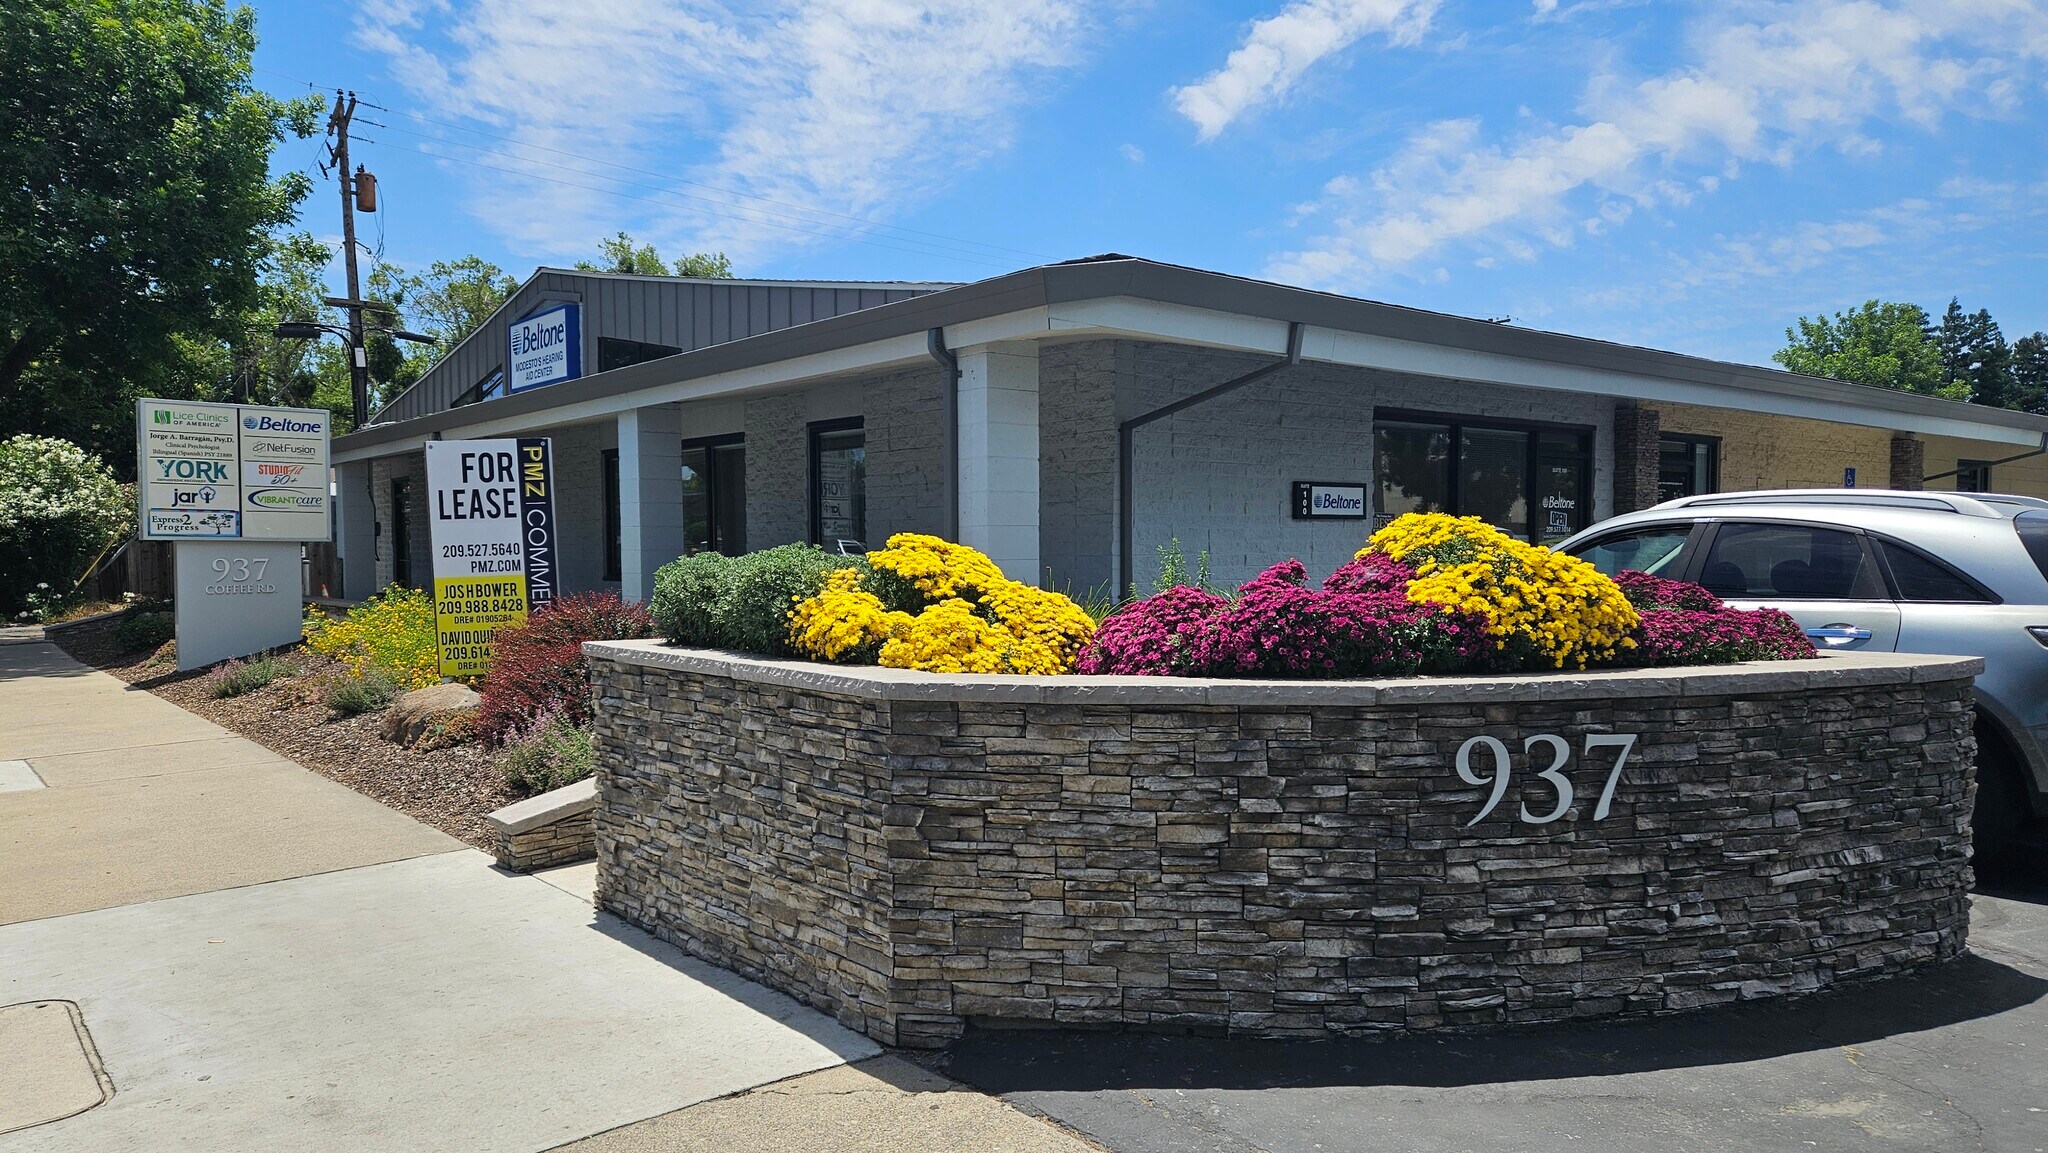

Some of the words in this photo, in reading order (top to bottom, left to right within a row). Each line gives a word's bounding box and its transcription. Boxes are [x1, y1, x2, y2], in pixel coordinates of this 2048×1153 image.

[522, 323, 564, 354] Beltone
[516, 357, 541, 372] MODESTO'S
[543, 351, 563, 365] HEARING
[534, 366, 552, 379] CENTER
[173, 411, 194, 420] Lice
[196, 412, 229, 423] Clinics
[258, 416, 321, 433] Beltone
[187, 443, 220, 451] Psychologist
[214, 436, 235, 444] Psy.D.
[267, 442, 315, 454] NetFusion
[258, 464, 288, 475] STUDIO
[461, 452, 515, 483] FOR
[523, 446, 546, 497] PMZ
[270, 475, 298, 485] 50+
[172, 489, 198, 507] jar
[438, 488, 517, 520] LEASE
[1323, 493, 1361, 509] Beltone
[1548, 496, 1575, 509] Beltone
[1551, 512, 1566, 526] OPEN
[157, 524, 199, 533] Progress
[443, 543, 520, 558] 209.527.5640
[471, 560, 521, 573] PMZ.COM
[527, 509, 551, 612] COMMER
[211, 558, 270, 582] 937
[205, 584, 253, 595] COFFEE
[257, 584, 278, 594] RD.
[444, 584, 474, 599] JOSH
[476, 583, 517, 597] BOWER
[438, 598, 523, 614] 209.988.8428
[454, 616, 474, 624] DRE#
[441, 630, 471, 645] DAVID
[445, 646, 491, 660] 209.614
[458, 662, 478, 670] DRE#
[1455, 734, 1638, 827] 937
